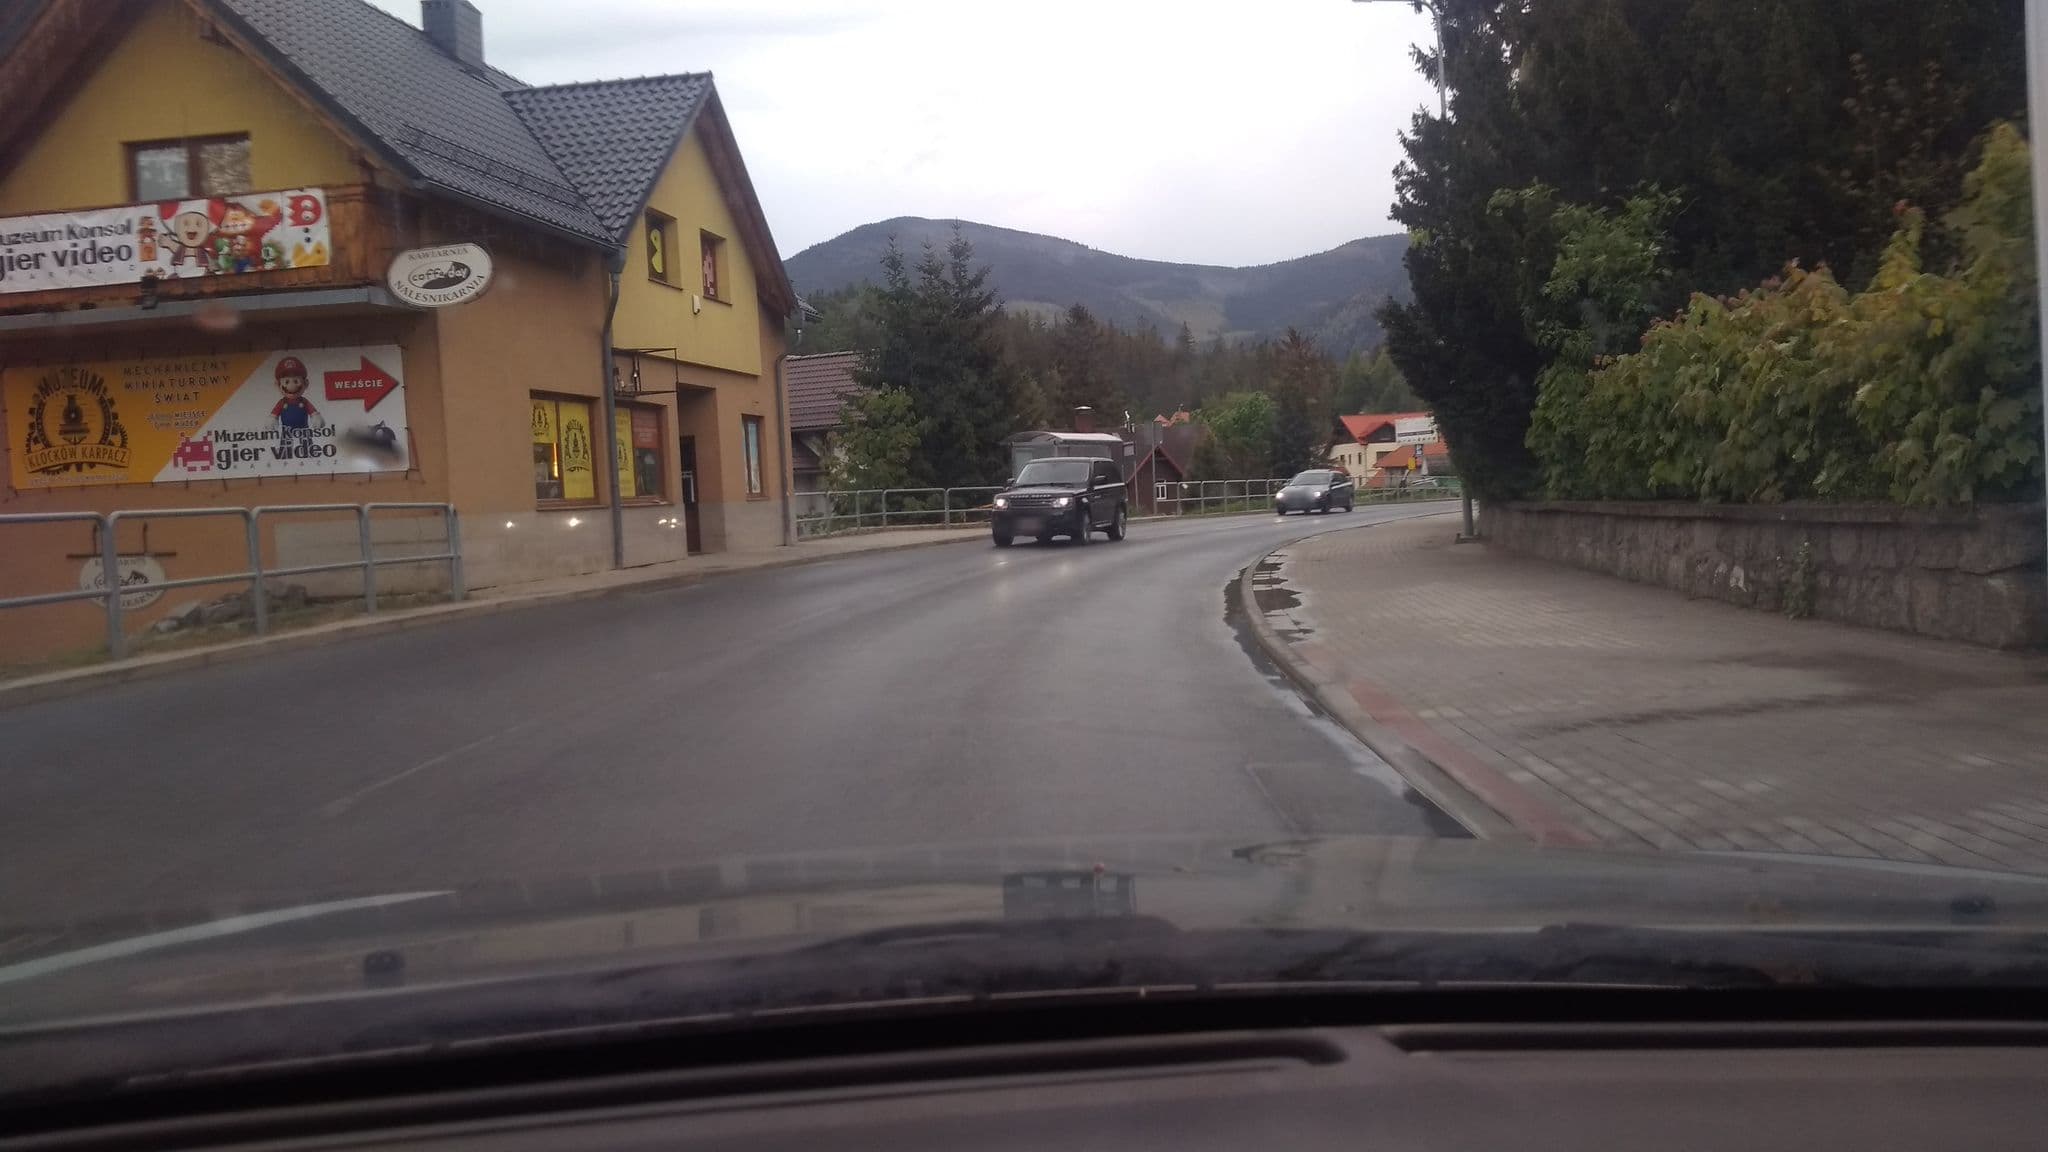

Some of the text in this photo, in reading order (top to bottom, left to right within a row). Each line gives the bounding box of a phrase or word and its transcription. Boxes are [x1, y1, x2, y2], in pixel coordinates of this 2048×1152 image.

[66, 218, 132, 241] Konsol
[51, 239, 133, 268] video
[123, 361, 228, 377] MECHANICZNY
[124, 375, 230, 391] MINIATUROWY
[334, 378, 384, 389] WEJŚCIE
[214, 424, 336, 443] Muzeum Konsol
[81, 446, 127, 463] KARPACZ
[216, 437, 337, 471] gier video
